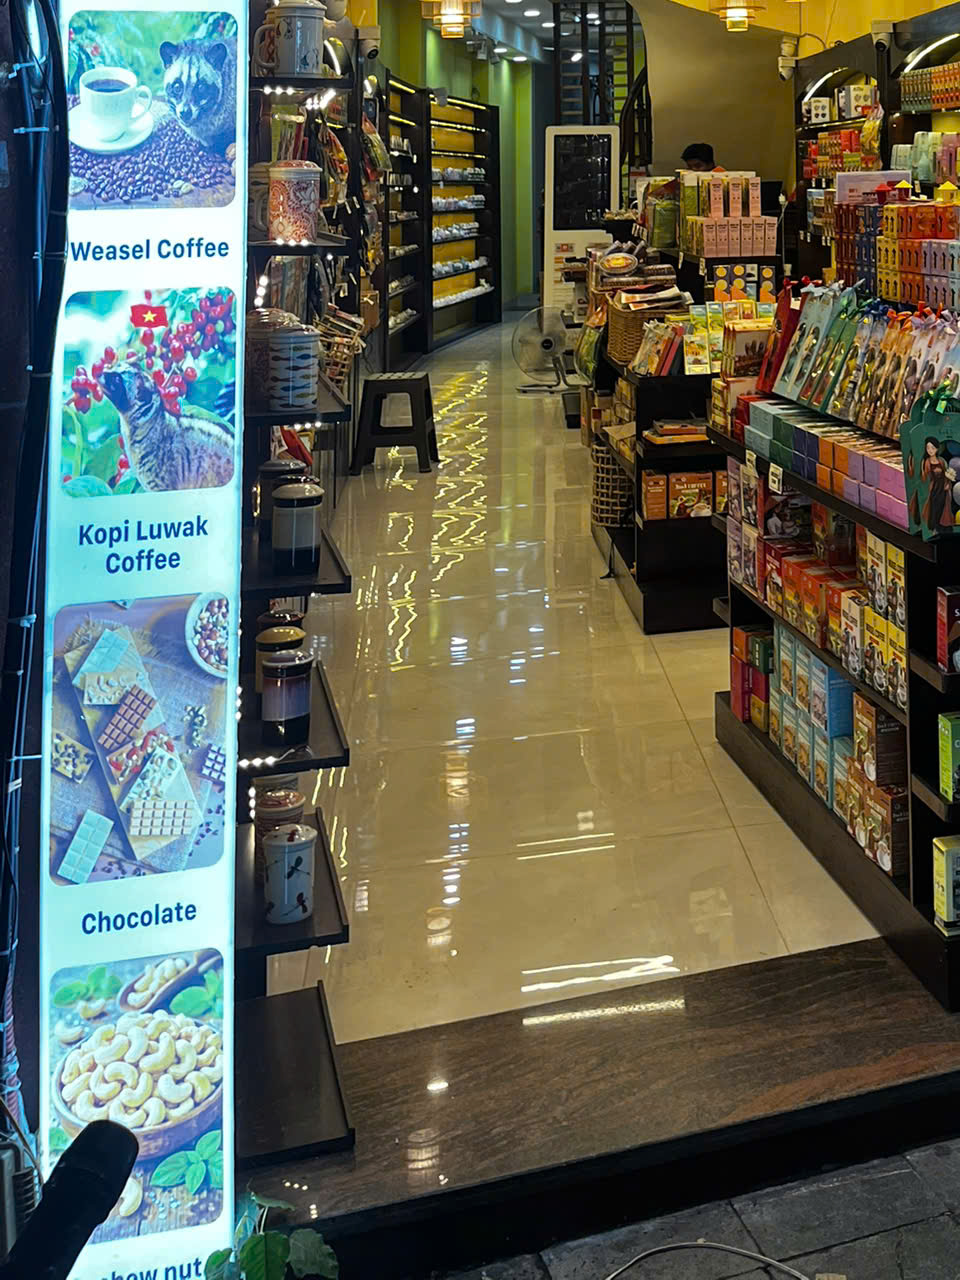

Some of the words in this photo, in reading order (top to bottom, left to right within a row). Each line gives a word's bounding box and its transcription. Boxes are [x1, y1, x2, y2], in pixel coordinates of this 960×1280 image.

[70, 239, 151, 262] Weasel
[157, 237, 230, 260] Coffee
[78, 519, 130, 549] Kopi
[136, 514, 209, 542] Luwak
[105, 548, 181, 575] Coffee
[81, 900, 198, 935] Chocolate
[164, 1257, 202, 1280] nut
